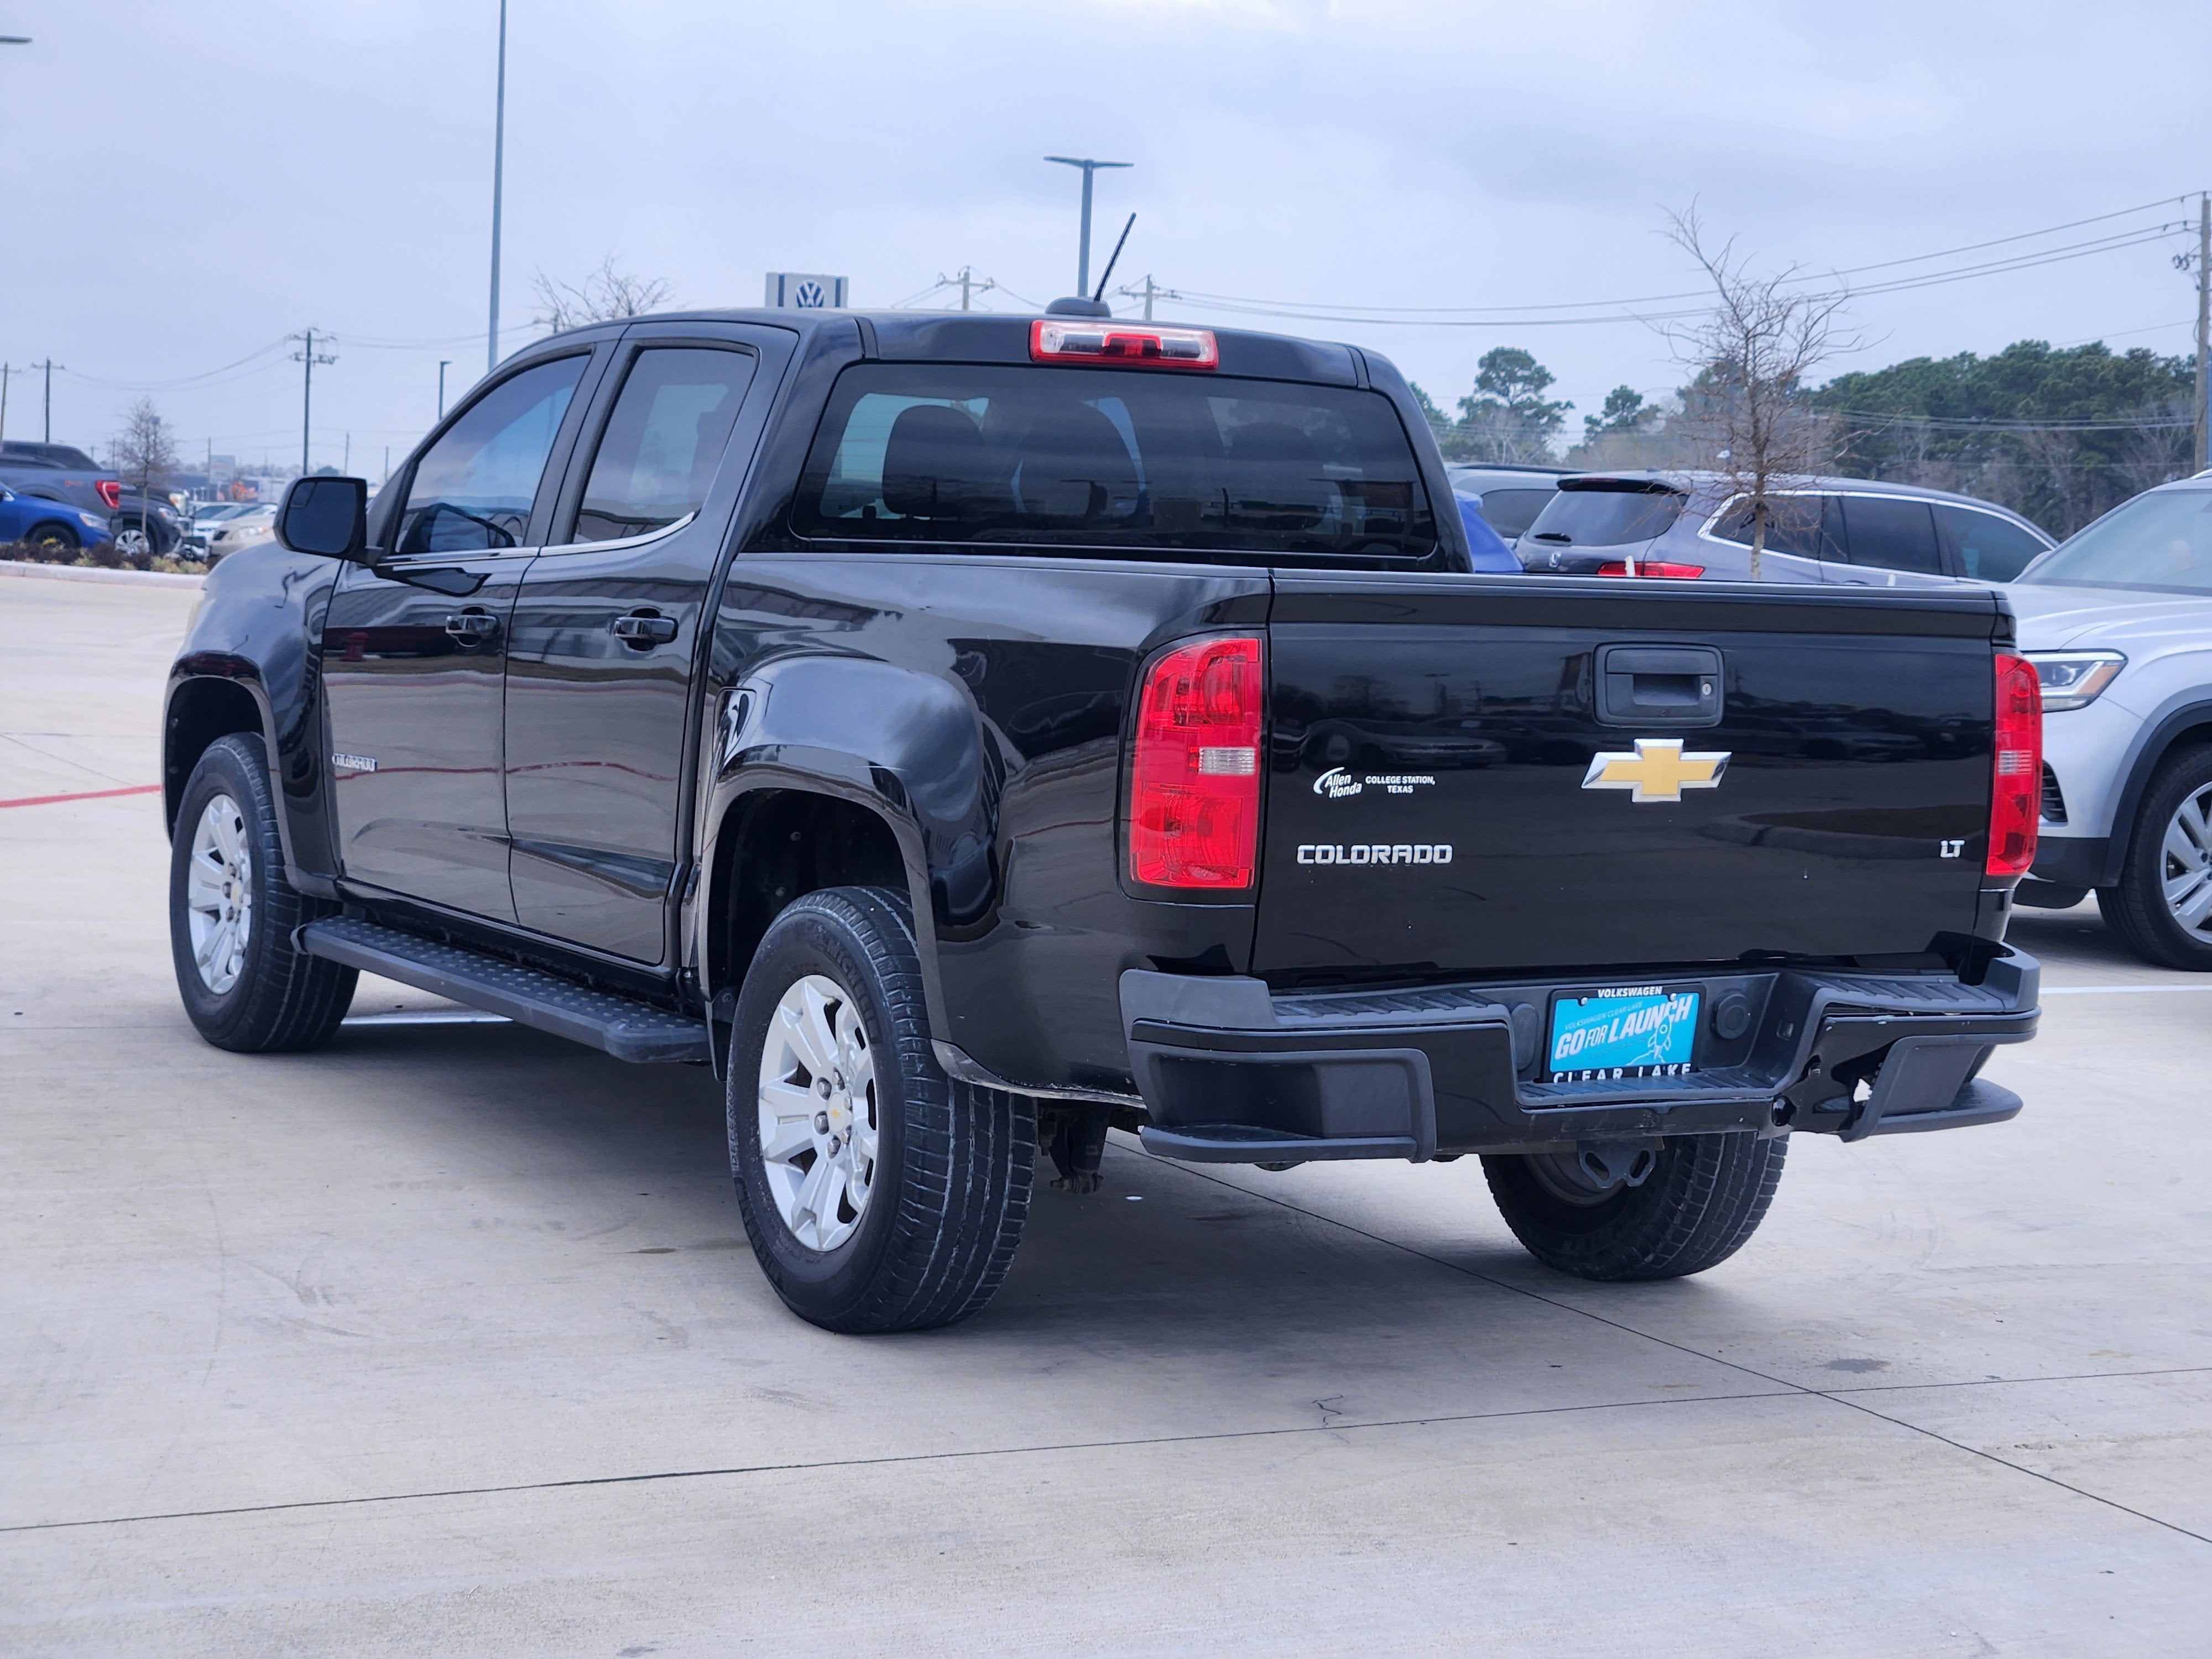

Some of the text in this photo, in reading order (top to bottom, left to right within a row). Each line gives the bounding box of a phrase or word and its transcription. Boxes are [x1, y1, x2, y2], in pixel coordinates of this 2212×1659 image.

[1324, 774, 1352, 789] Allen
[1365, 775, 1436, 785] COLLEGE STATION,
[1328, 782, 1363, 799] Honda
[1387, 785, 1413, 794] TEXAS
[1297, 844, 1453, 864] COLORADO
[1940, 839, 1965, 858] LT
[1597, 986, 1663, 998] VOLKSWAGEN
[1554, 1029, 1587, 1060] GO
[1584, 1025, 1609, 1049] FOR
[1608, 995, 1694, 1044] LAUNCH
